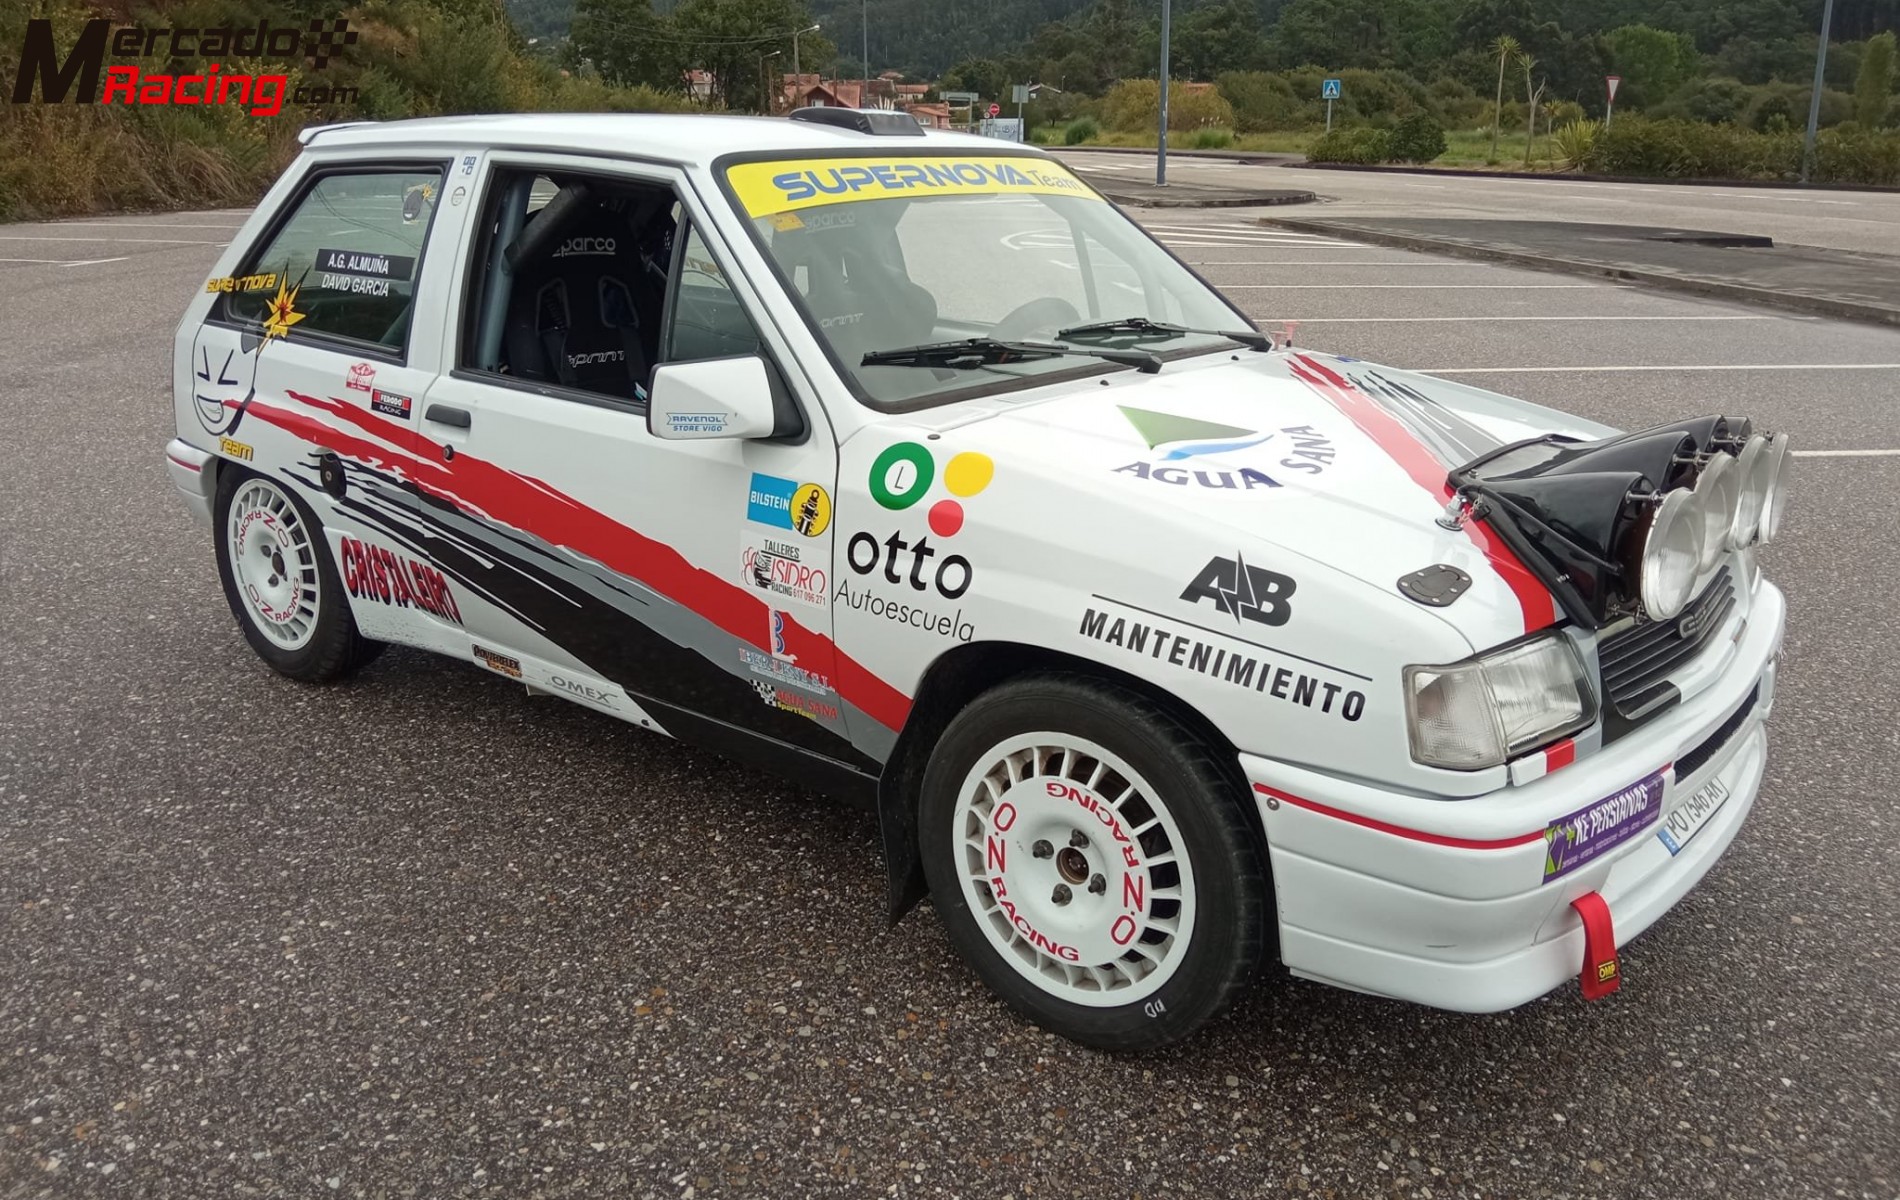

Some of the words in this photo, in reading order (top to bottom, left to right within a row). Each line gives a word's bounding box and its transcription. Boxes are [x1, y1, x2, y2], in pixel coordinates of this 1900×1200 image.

[773, 164, 1035, 202] SUPERNOVA
[1026, 170, 1083, 192] Team
[328, 253, 345, 269] A.G.
[347, 255, 389, 275] ALMUIÑA
[321, 274, 351, 293] DAVID
[351, 278, 390, 297] GARCIA
[1279, 425, 1337, 475] SANA
[894, 466, 905, 490] L
[1111, 460, 1284, 490] AGUA
[750, 490, 790, 512] BILSTEIN
[764, 539, 800, 559] TALLERES
[847, 530, 973, 600] otto
[771, 558, 826, 594] ISIDRO
[771, 581, 793, 597] RACING
[275, 577, 299, 622] RACING
[834, 578, 975, 642] Autoescuela
[1079, 608, 1366, 722] MANTENIMIENTO
[551, 676, 618, 704] OMEX
[808, 698, 839, 719] SANA
[1046, 782, 1140, 868] RACING
[1590, 783, 1648, 838] PERSIANAS
[991, 877, 1080, 961] RACING
[1599, 963, 1616, 979] OMP
